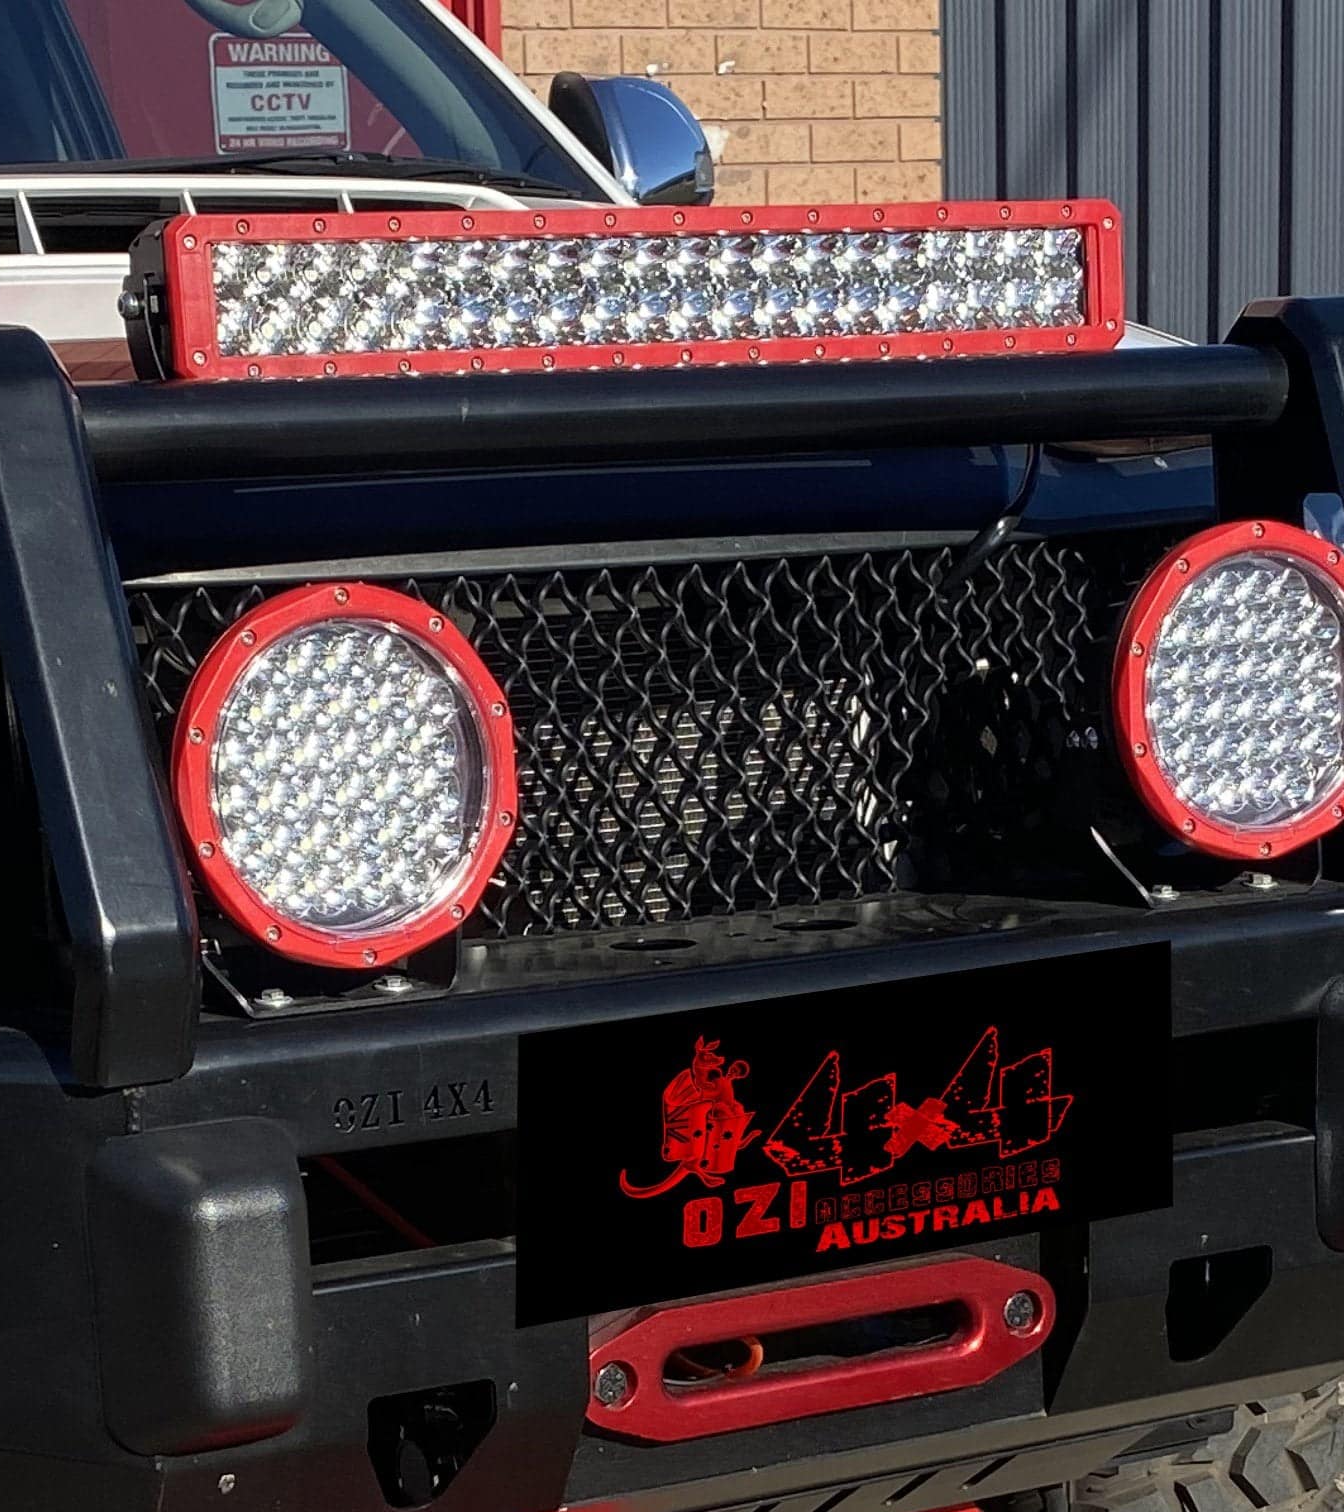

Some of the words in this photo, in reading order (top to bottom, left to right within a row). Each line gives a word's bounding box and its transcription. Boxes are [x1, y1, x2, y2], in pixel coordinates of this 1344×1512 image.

[227, 42, 331, 63] WARNING
[250, 93, 312, 112] CCTV
[332, 1089, 405, 1134] OZI
[422, 1078, 495, 1121] 4X4
